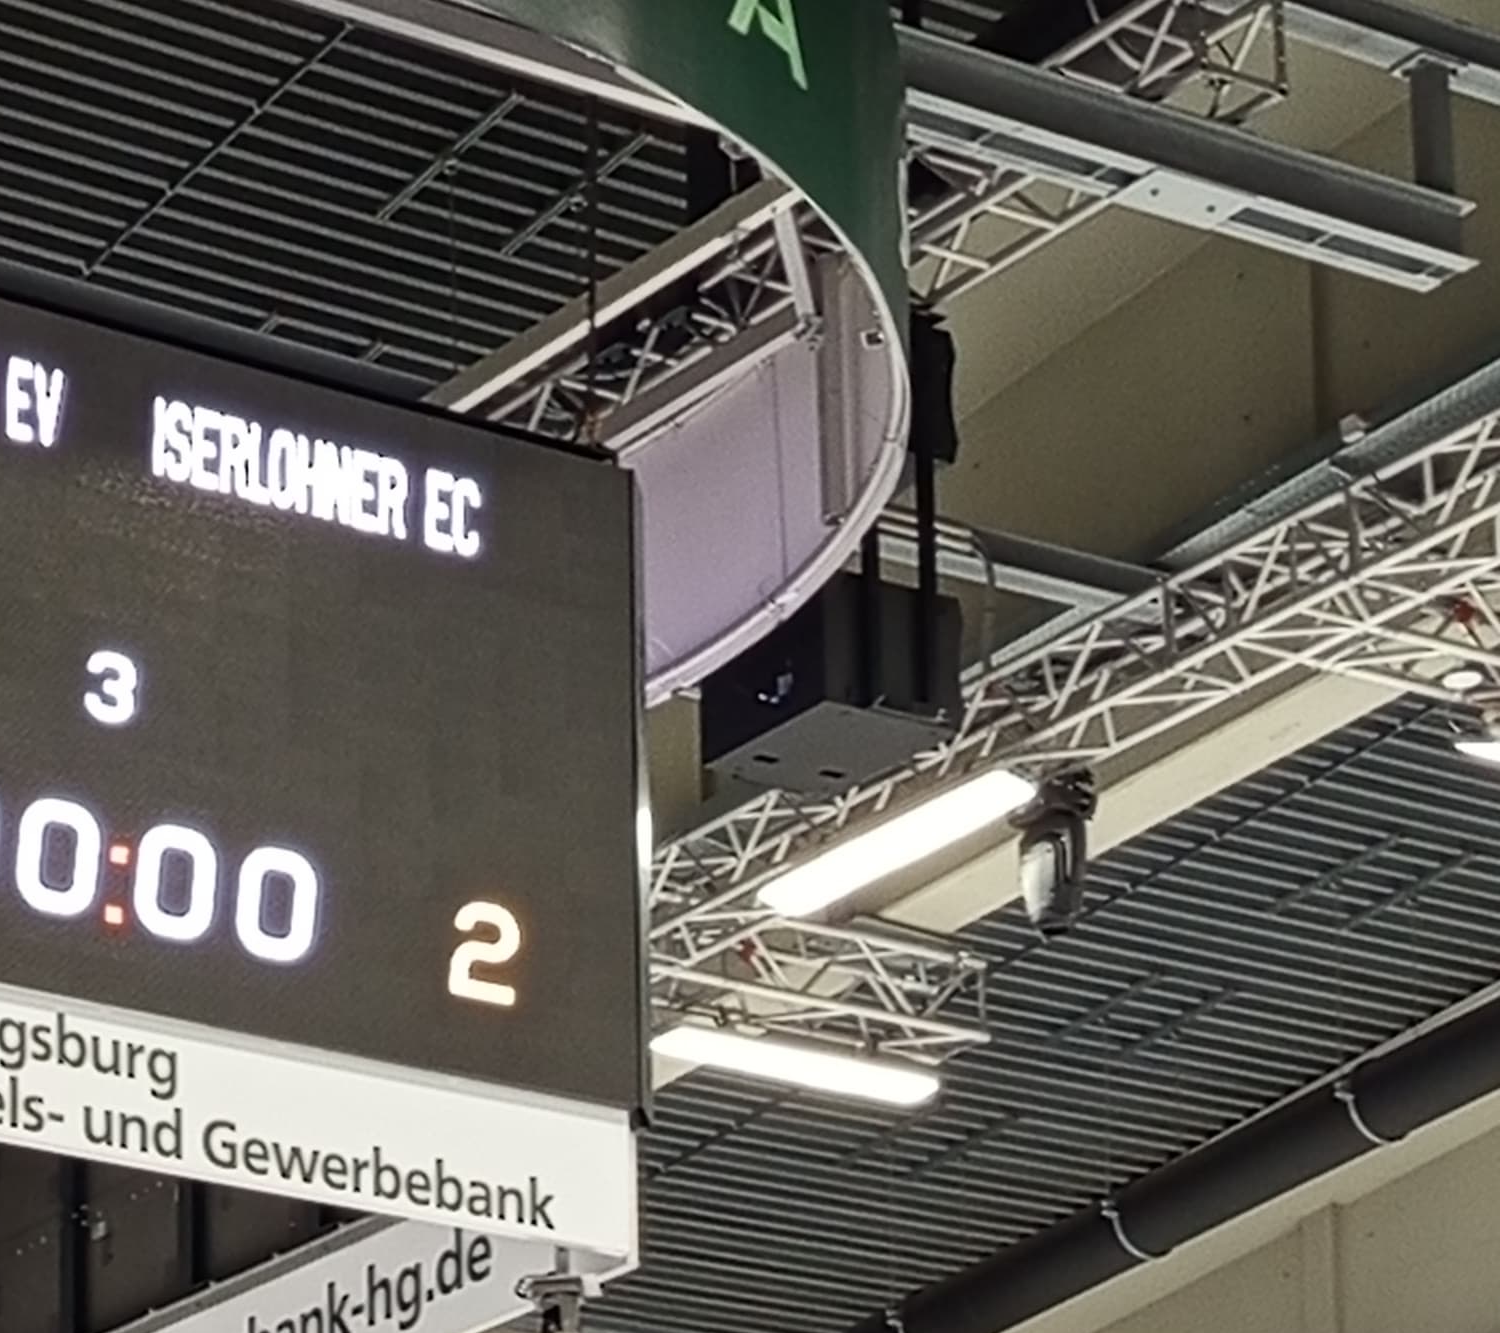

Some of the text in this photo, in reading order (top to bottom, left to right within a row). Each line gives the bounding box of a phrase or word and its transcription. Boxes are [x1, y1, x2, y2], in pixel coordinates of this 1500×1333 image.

[5, 356, 64, 447] EV
[152, 396, 482, 557] ISERLOHNER EC
[84, 651, 137, 724] 3
[448, 901, 521, 1006] 2
[84, 1108, 184, 1159] und
[202, 1121, 556, 1230] Gewerbebank
